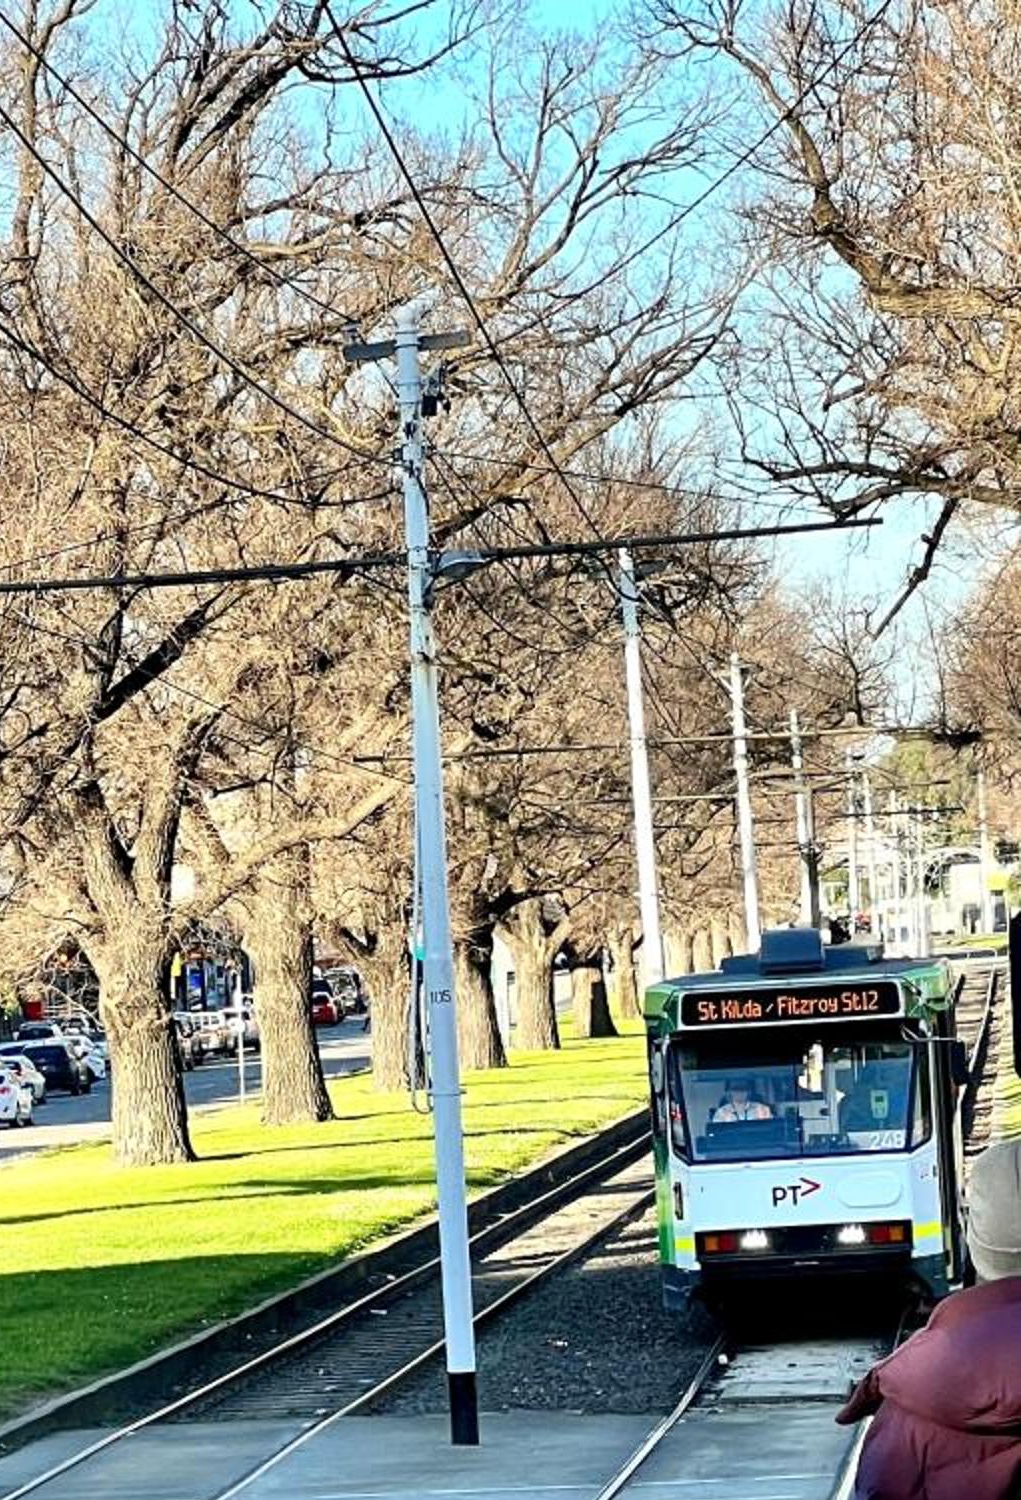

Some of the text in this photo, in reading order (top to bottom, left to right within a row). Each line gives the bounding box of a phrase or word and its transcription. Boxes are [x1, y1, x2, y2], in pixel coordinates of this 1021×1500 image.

[430, 989, 452, 1004] 105
[697, 1001, 718, 1021] St
[721, 999, 762, 1019] Kilda
[777, 995, 838, 1017] Fitzroy
[869, 1132, 906, 1150] 248
